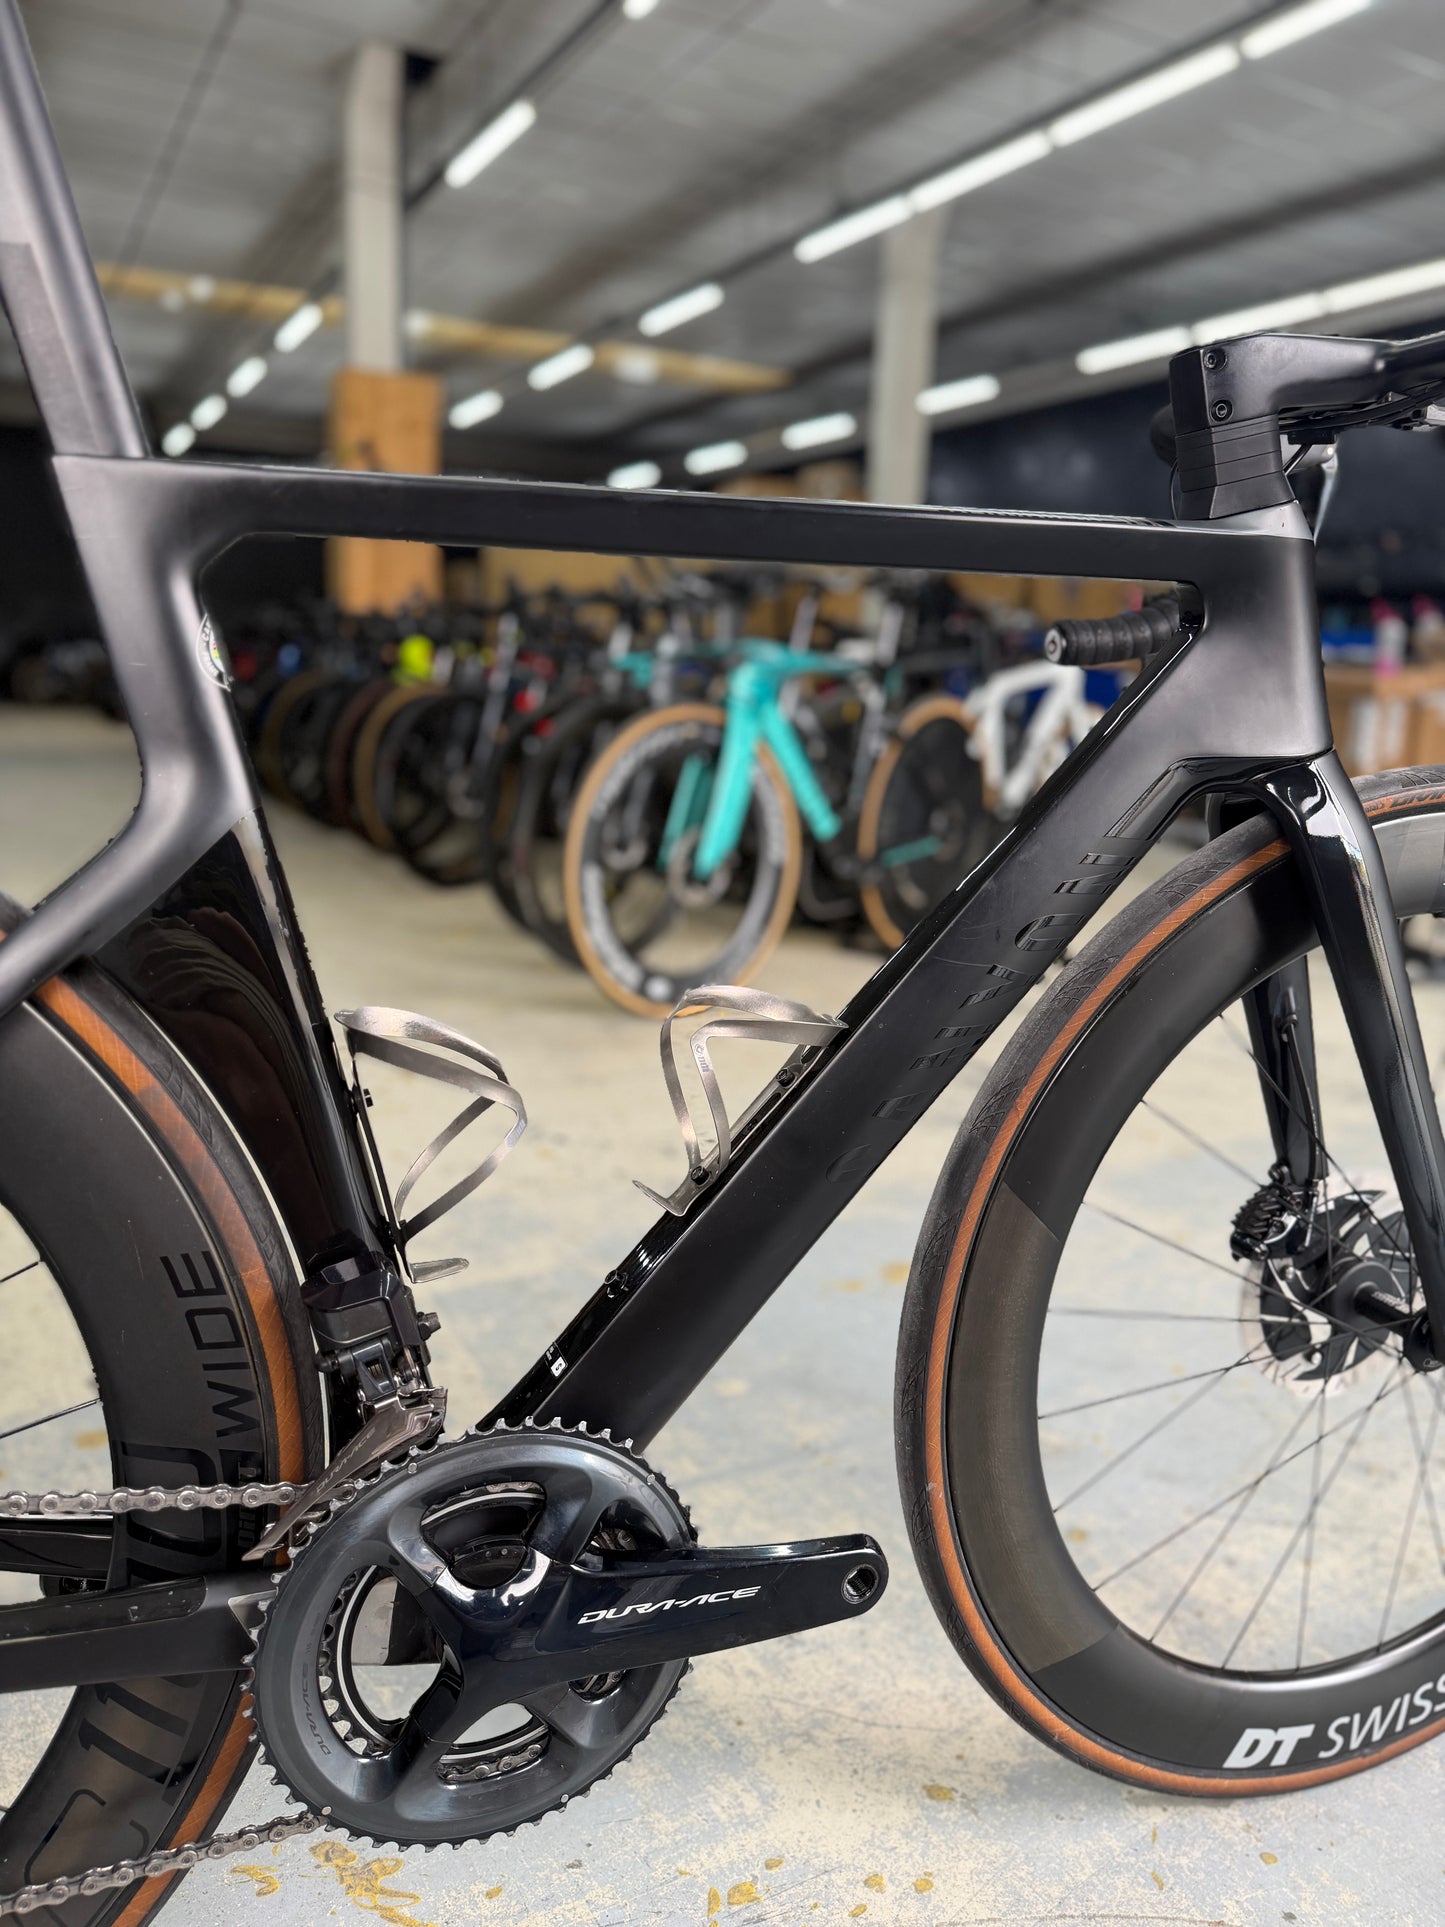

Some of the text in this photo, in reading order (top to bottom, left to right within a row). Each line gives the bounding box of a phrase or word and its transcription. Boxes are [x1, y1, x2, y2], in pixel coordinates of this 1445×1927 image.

[160, 1250, 262, 1438] WIDE
[577, 1585, 762, 1625] DURA-ACE
[1221, 1723, 1316, 1769] DT
